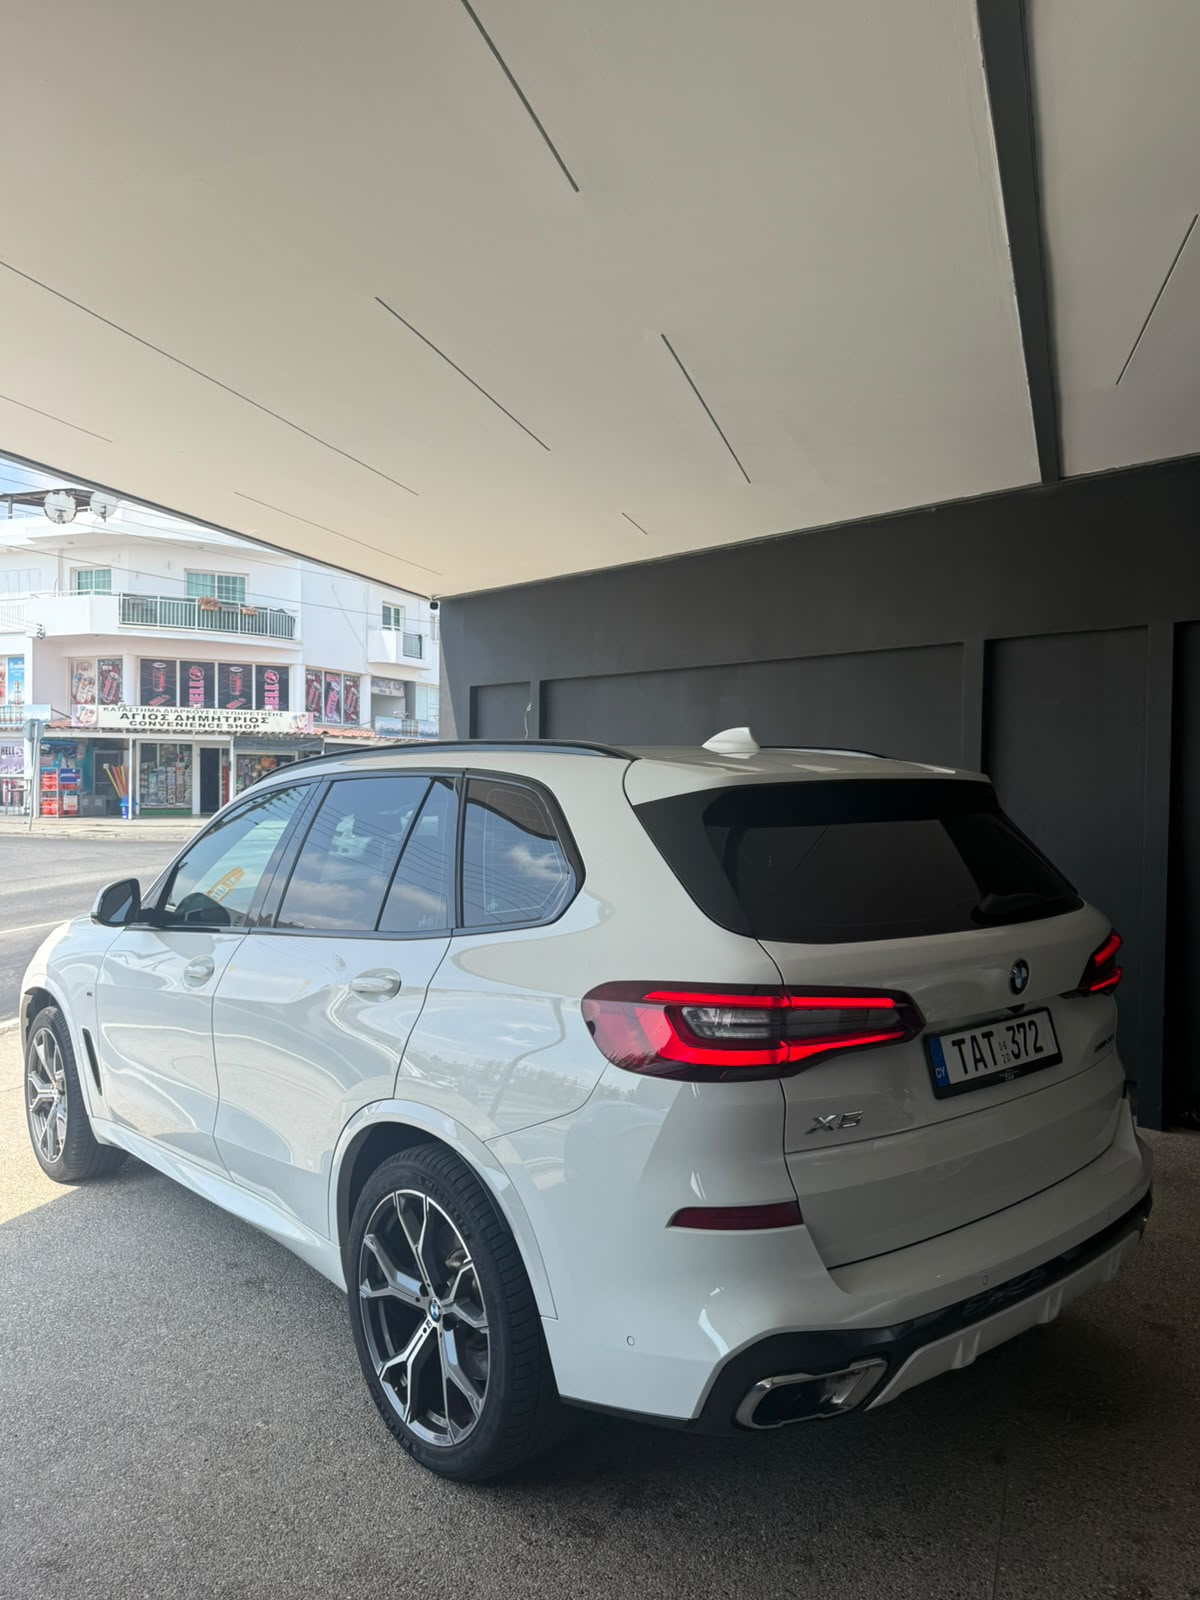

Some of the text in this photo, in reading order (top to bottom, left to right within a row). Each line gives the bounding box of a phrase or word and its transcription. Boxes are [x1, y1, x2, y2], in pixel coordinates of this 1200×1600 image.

[120, 712, 269, 723] ΑΓΙΟΣ ΔΗΜΗΤΡΙΟΣ
[129, 720, 223, 729] CONVENIENCE
[951, 1030, 997, 1074] TAT
[1006, 1020, 1044, 1060] 372
[935, 1066, 946, 1079] CY
[804, 1110, 864, 1134] X5
